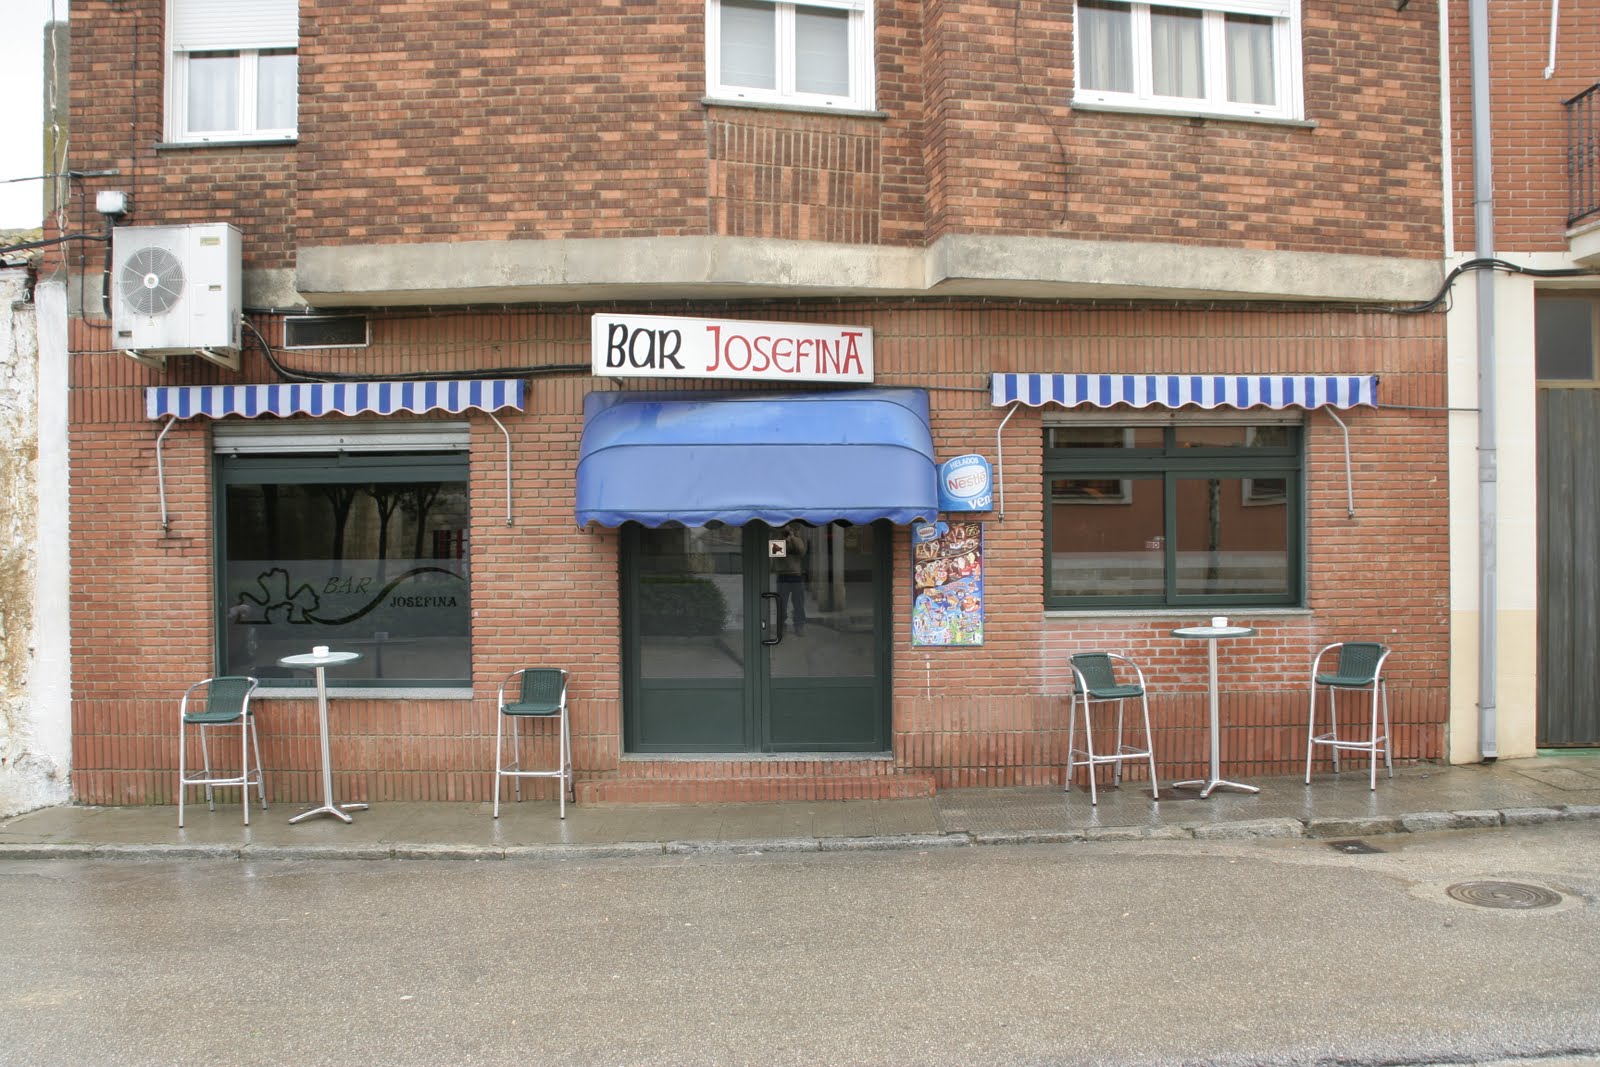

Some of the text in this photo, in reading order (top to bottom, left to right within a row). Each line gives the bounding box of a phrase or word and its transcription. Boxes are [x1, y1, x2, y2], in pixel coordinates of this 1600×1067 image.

[706, 325, 865, 375] JOSEFINA
[949, 456, 979, 470] HELADOS
[948, 471, 986, 491] Nestlé
[323, 576, 372, 595] BAR
[389, 596, 458, 608] JOSEFINA
